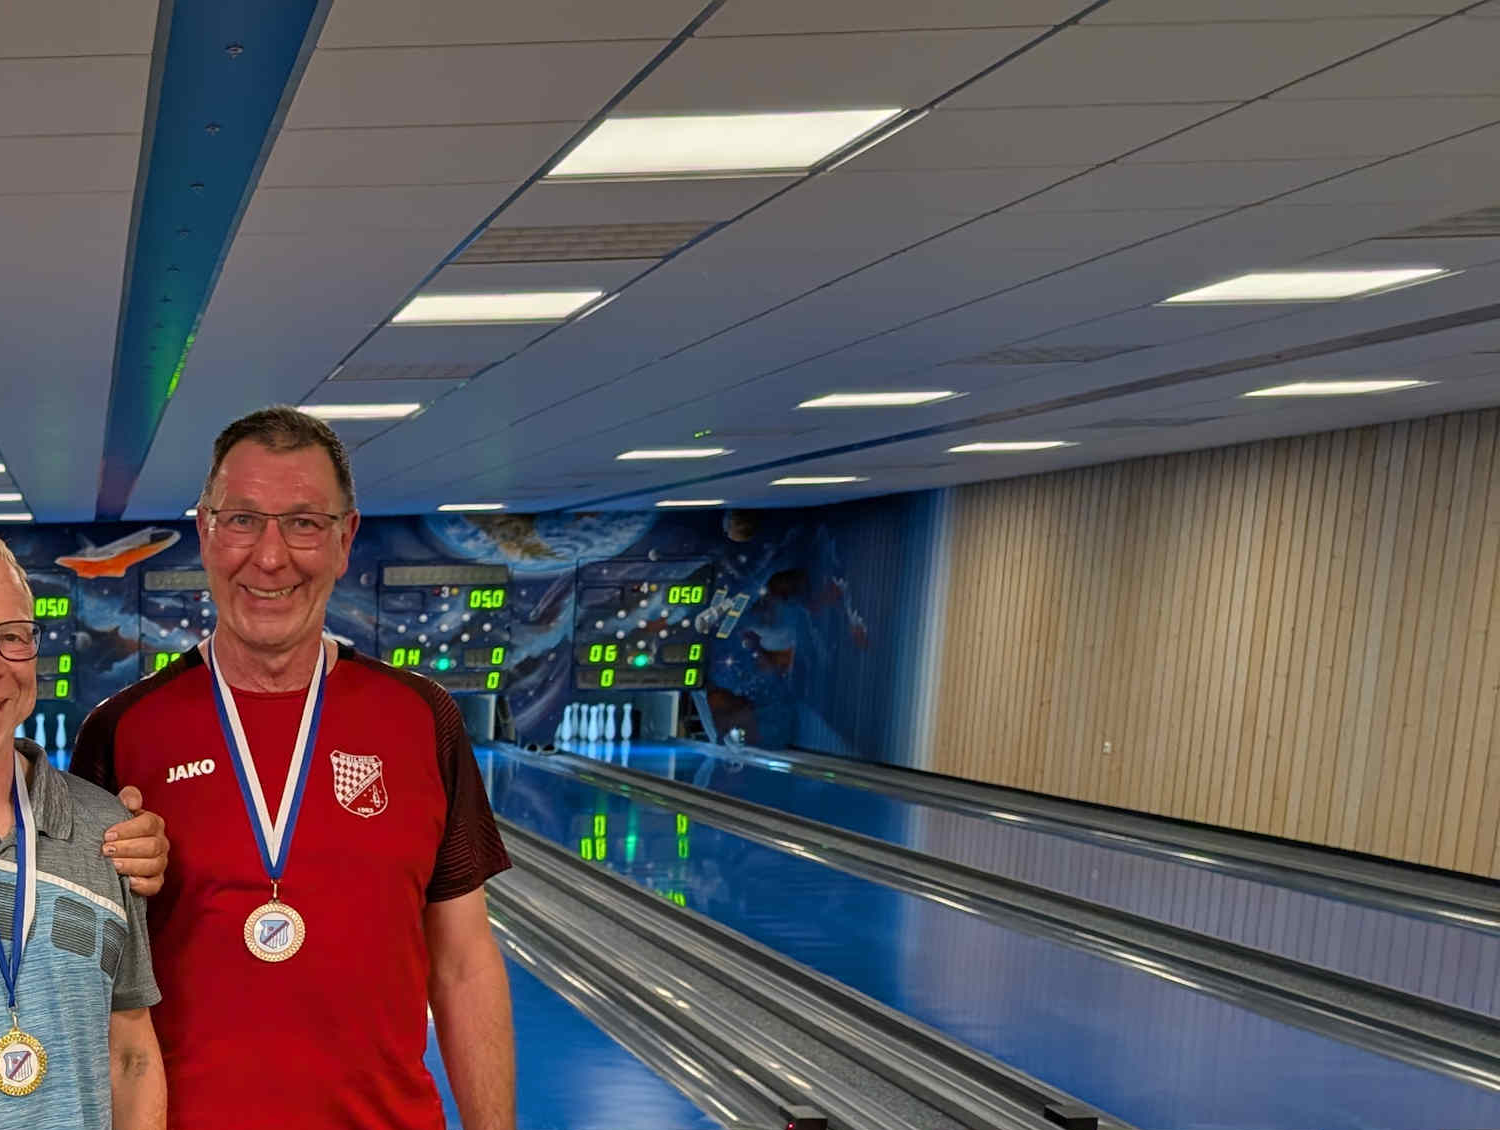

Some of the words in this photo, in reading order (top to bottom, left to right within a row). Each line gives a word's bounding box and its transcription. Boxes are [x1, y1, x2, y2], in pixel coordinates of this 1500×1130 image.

[201, 591, 211, 602] 2
[441, 586, 449, 598] 3
[640, 582, 649, 594] 4
[668, 586, 704, 604] 050
[470, 589, 505, 608] 050
[35, 598, 69, 617] 050
[492, 647, 504, 664] 0
[689, 644, 702, 661] 0
[58, 654, 71, 673] 0
[487, 672, 500, 689] 0
[601, 669, 615, 687] 0
[685, 669, 697, 685] 0
[56, 679, 68, 697] 0
[166, 758, 216, 784] JAKO
